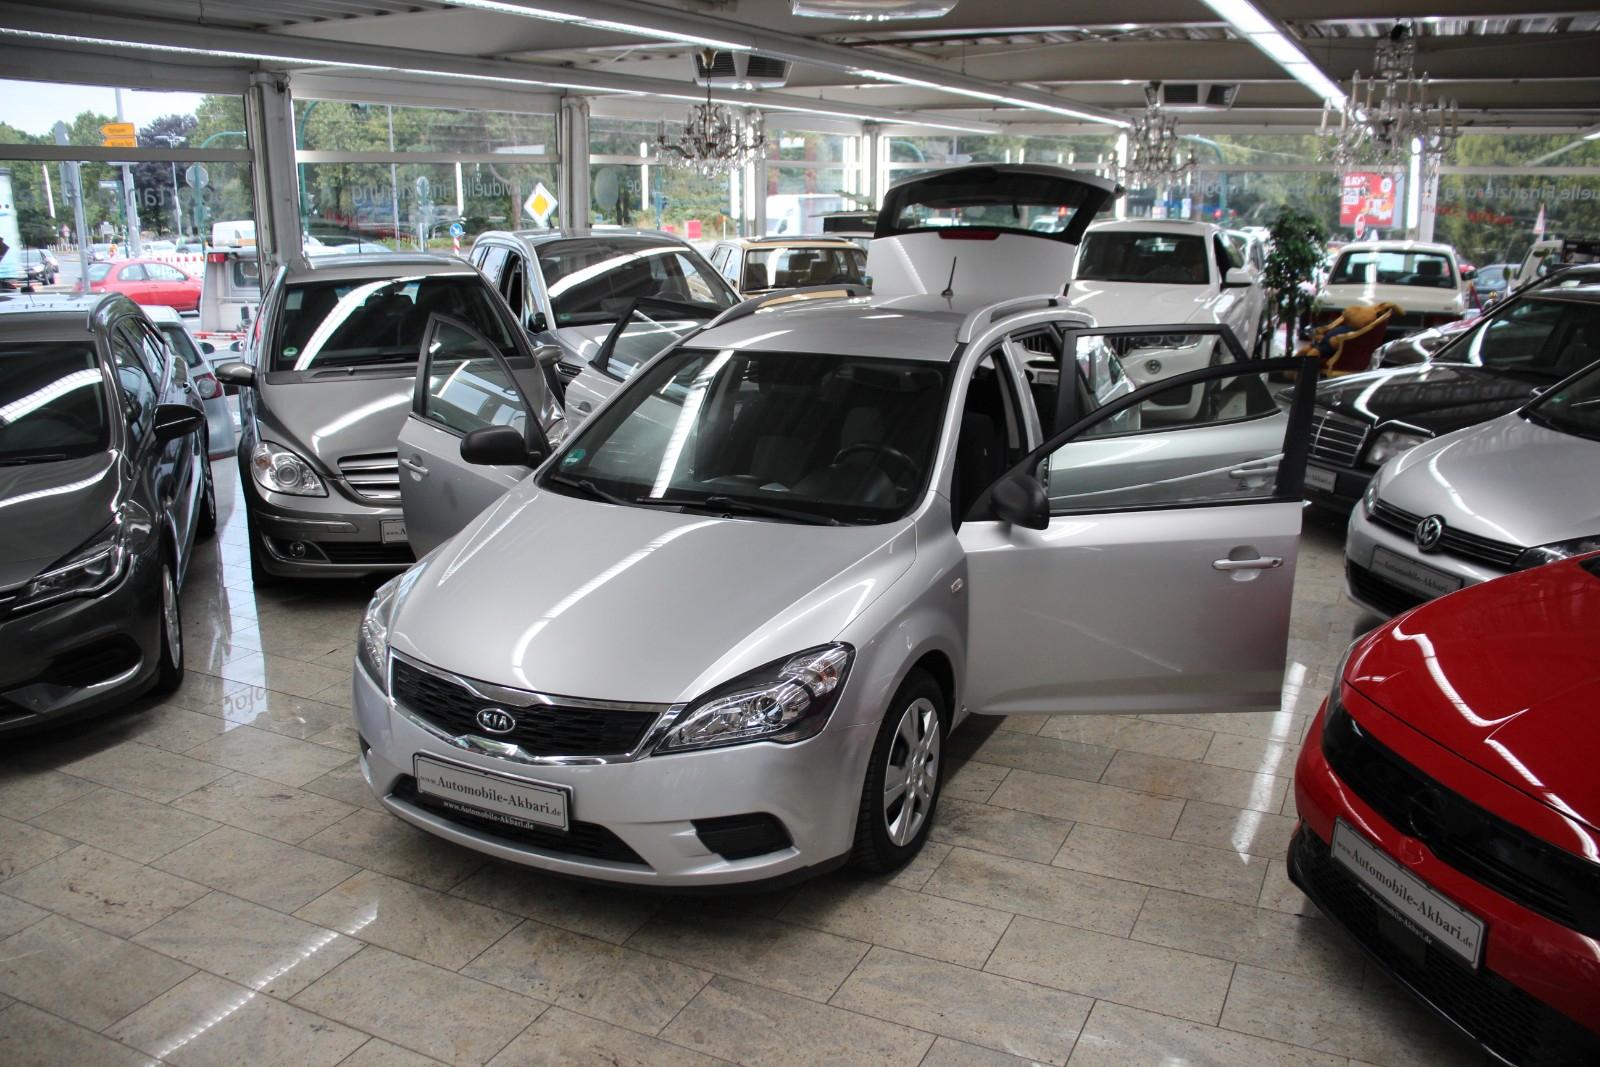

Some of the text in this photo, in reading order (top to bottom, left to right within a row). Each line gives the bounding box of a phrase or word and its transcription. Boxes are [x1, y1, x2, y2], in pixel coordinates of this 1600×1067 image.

[483, 711, 508, 730] KIA
[420, 775, 562, 816] www.Automobile-Akbari.de
[443, 801, 534, 830] www.Automobile-Akbari.de
[1337, 841, 1474, 949] www.Automobile-Akbari.de
